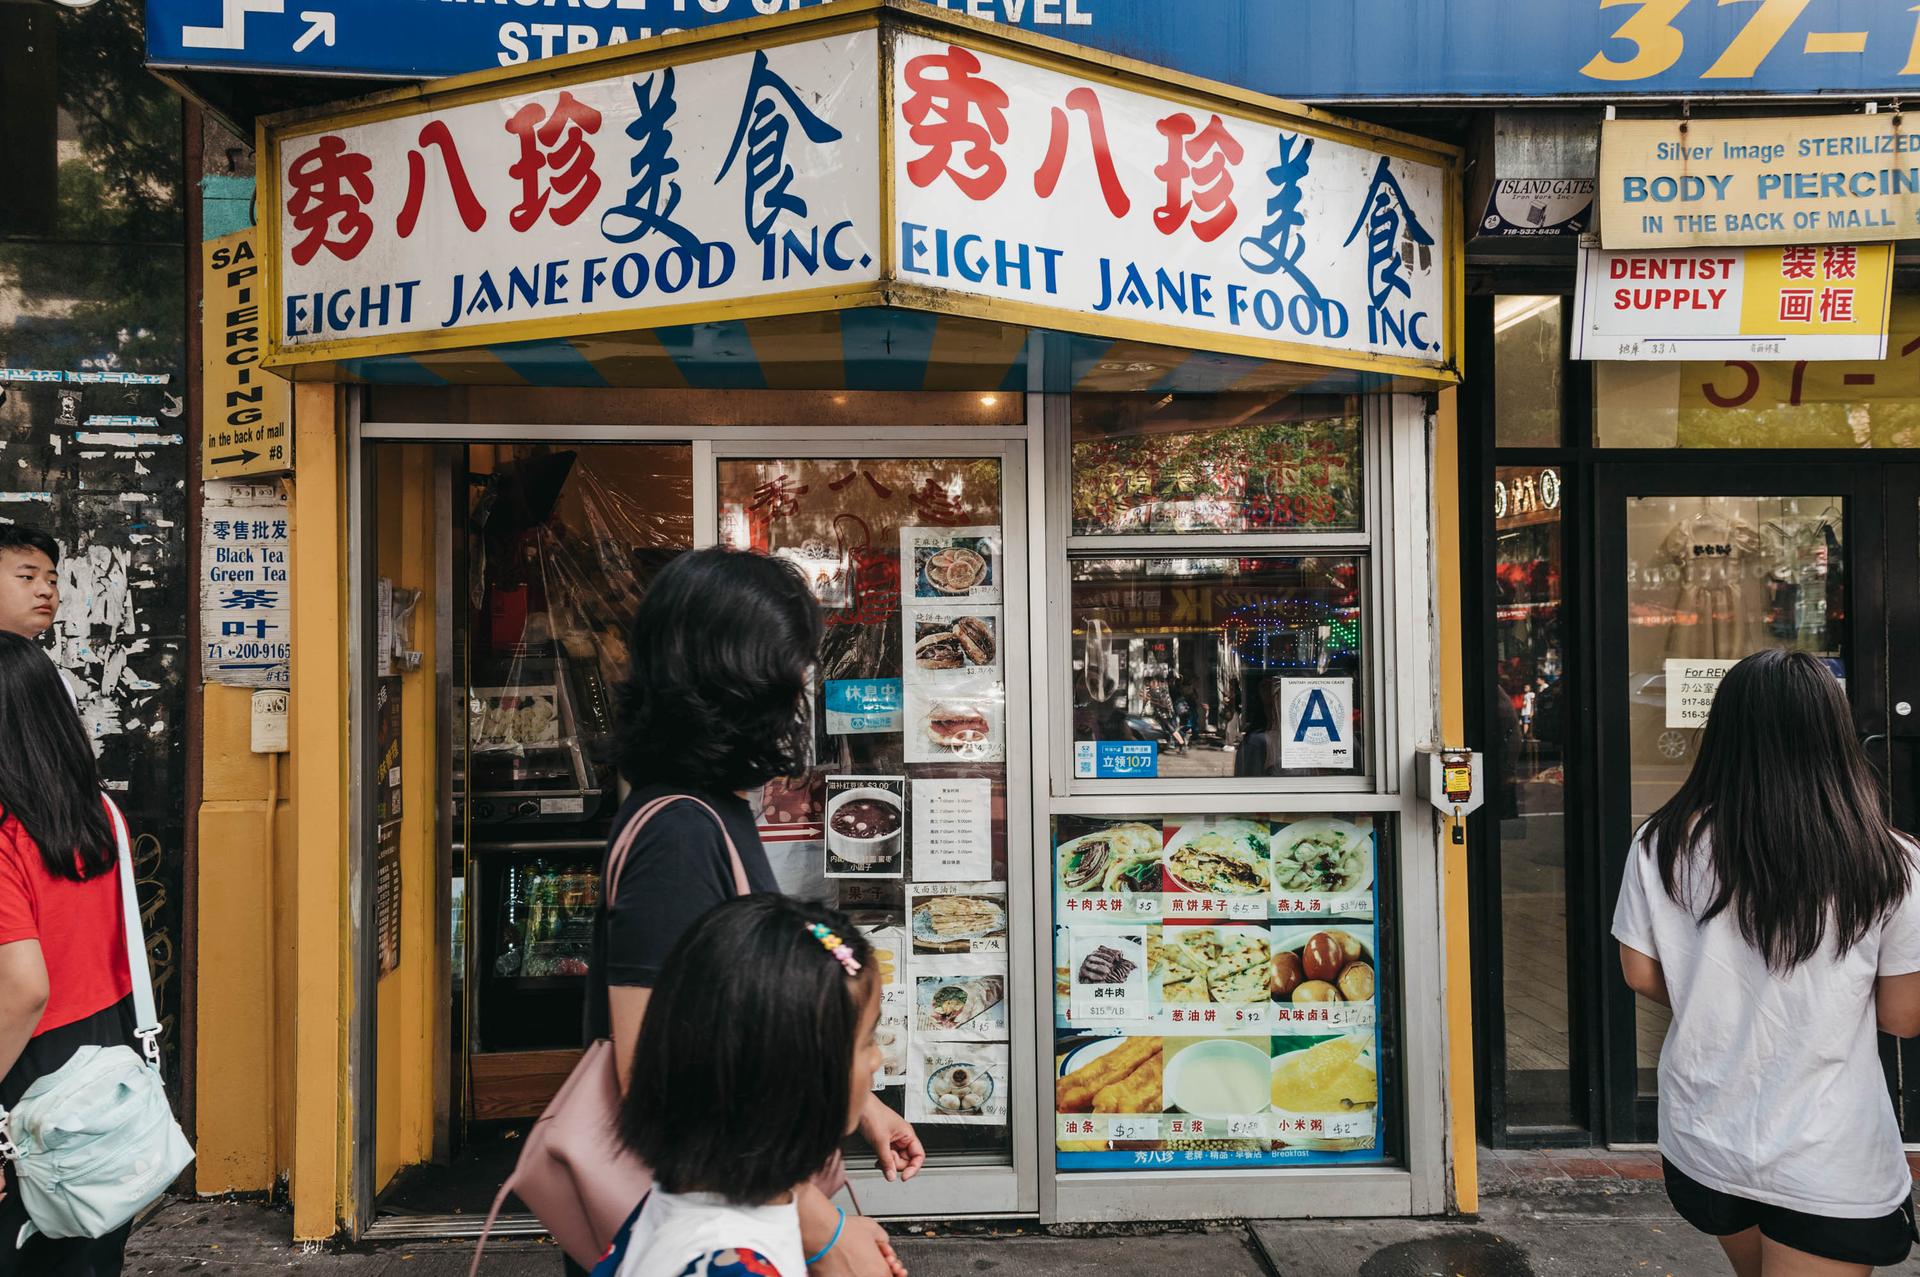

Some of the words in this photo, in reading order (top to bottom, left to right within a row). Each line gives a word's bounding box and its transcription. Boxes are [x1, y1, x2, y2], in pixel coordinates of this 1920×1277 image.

[1656, 141, 1713, 161] Silver
[1723, 140, 1785, 164] Image
[1797, 134, 1920, 157] STERILIZED
[286, 49, 842, 266] 秀八珍美食
[901, 45, 1435, 310] 秀八珍美食
[1501, 180, 1551, 194] ISLAND
[1552, 180, 1595, 194] GATES
[1622, 174, 1735, 204] BODY
[1641, 215, 1663, 233] IN
[1673, 214, 1718, 233] THE
[1724, 212, 1786, 232] BACK
[1793, 211, 1821, 230] OF
[1827, 208, 1896, 229] MALL
[1609, 258, 1737, 281] DENTIST
[286, 280, 421, 337] EIGHT
[441, 259, 570, 328] JANE
[581, 241, 736, 303] FOOD
[762, 219, 872, 282] INC.
[901, 222, 1064, 295] EIGHT
[1092, 257, 1215, 318] JANE
[1227, 283, 1350, 339] FOOD
[1367, 304, 1441, 353] INC.
[1613, 288, 1728, 311] SUPPLY
[1778, 288, 1855, 323] 画框
[208, 434, 217, 448] in
[218, 431, 232, 446] the
[234, 428, 253, 445] back
[255, 426, 265, 441] of
[267, 422, 285, 440] mall
[269, 445, 283, 461] #8
[213, 520, 288, 541] 零售批发
[216, 547, 254, 563] Black
[261, 547, 285, 563] Tea
[210, 566, 254, 582] Green
[262, 565, 288, 582] Tea
[1685, 668, 1703, 678] For
[844, 683, 896, 702] 休息中
[1293, 689, 1341, 742] A
[1066, 898, 1123, 911] 牛肉夹饼
[1138, 901, 1152, 911] $5
[1172, 898, 1228, 912] 煎饼果子
[1278, 899, 1321, 912] 燕丸汤
[1094, 987, 1125, 998] 卤牛肉
[1172, 1010, 1217, 1022] 葱油饼
[1247, 1012, 1261, 1021] $2
[1066, 1120, 1094, 1133] 油条
[1171, 1120, 1204, 1133] 豆浆
[1278, 1119, 1322, 1131] 小米粥
[1134, 1151, 1175, 1164] 秀八珍
[1271, 1150, 1310, 1158] Breakfast
